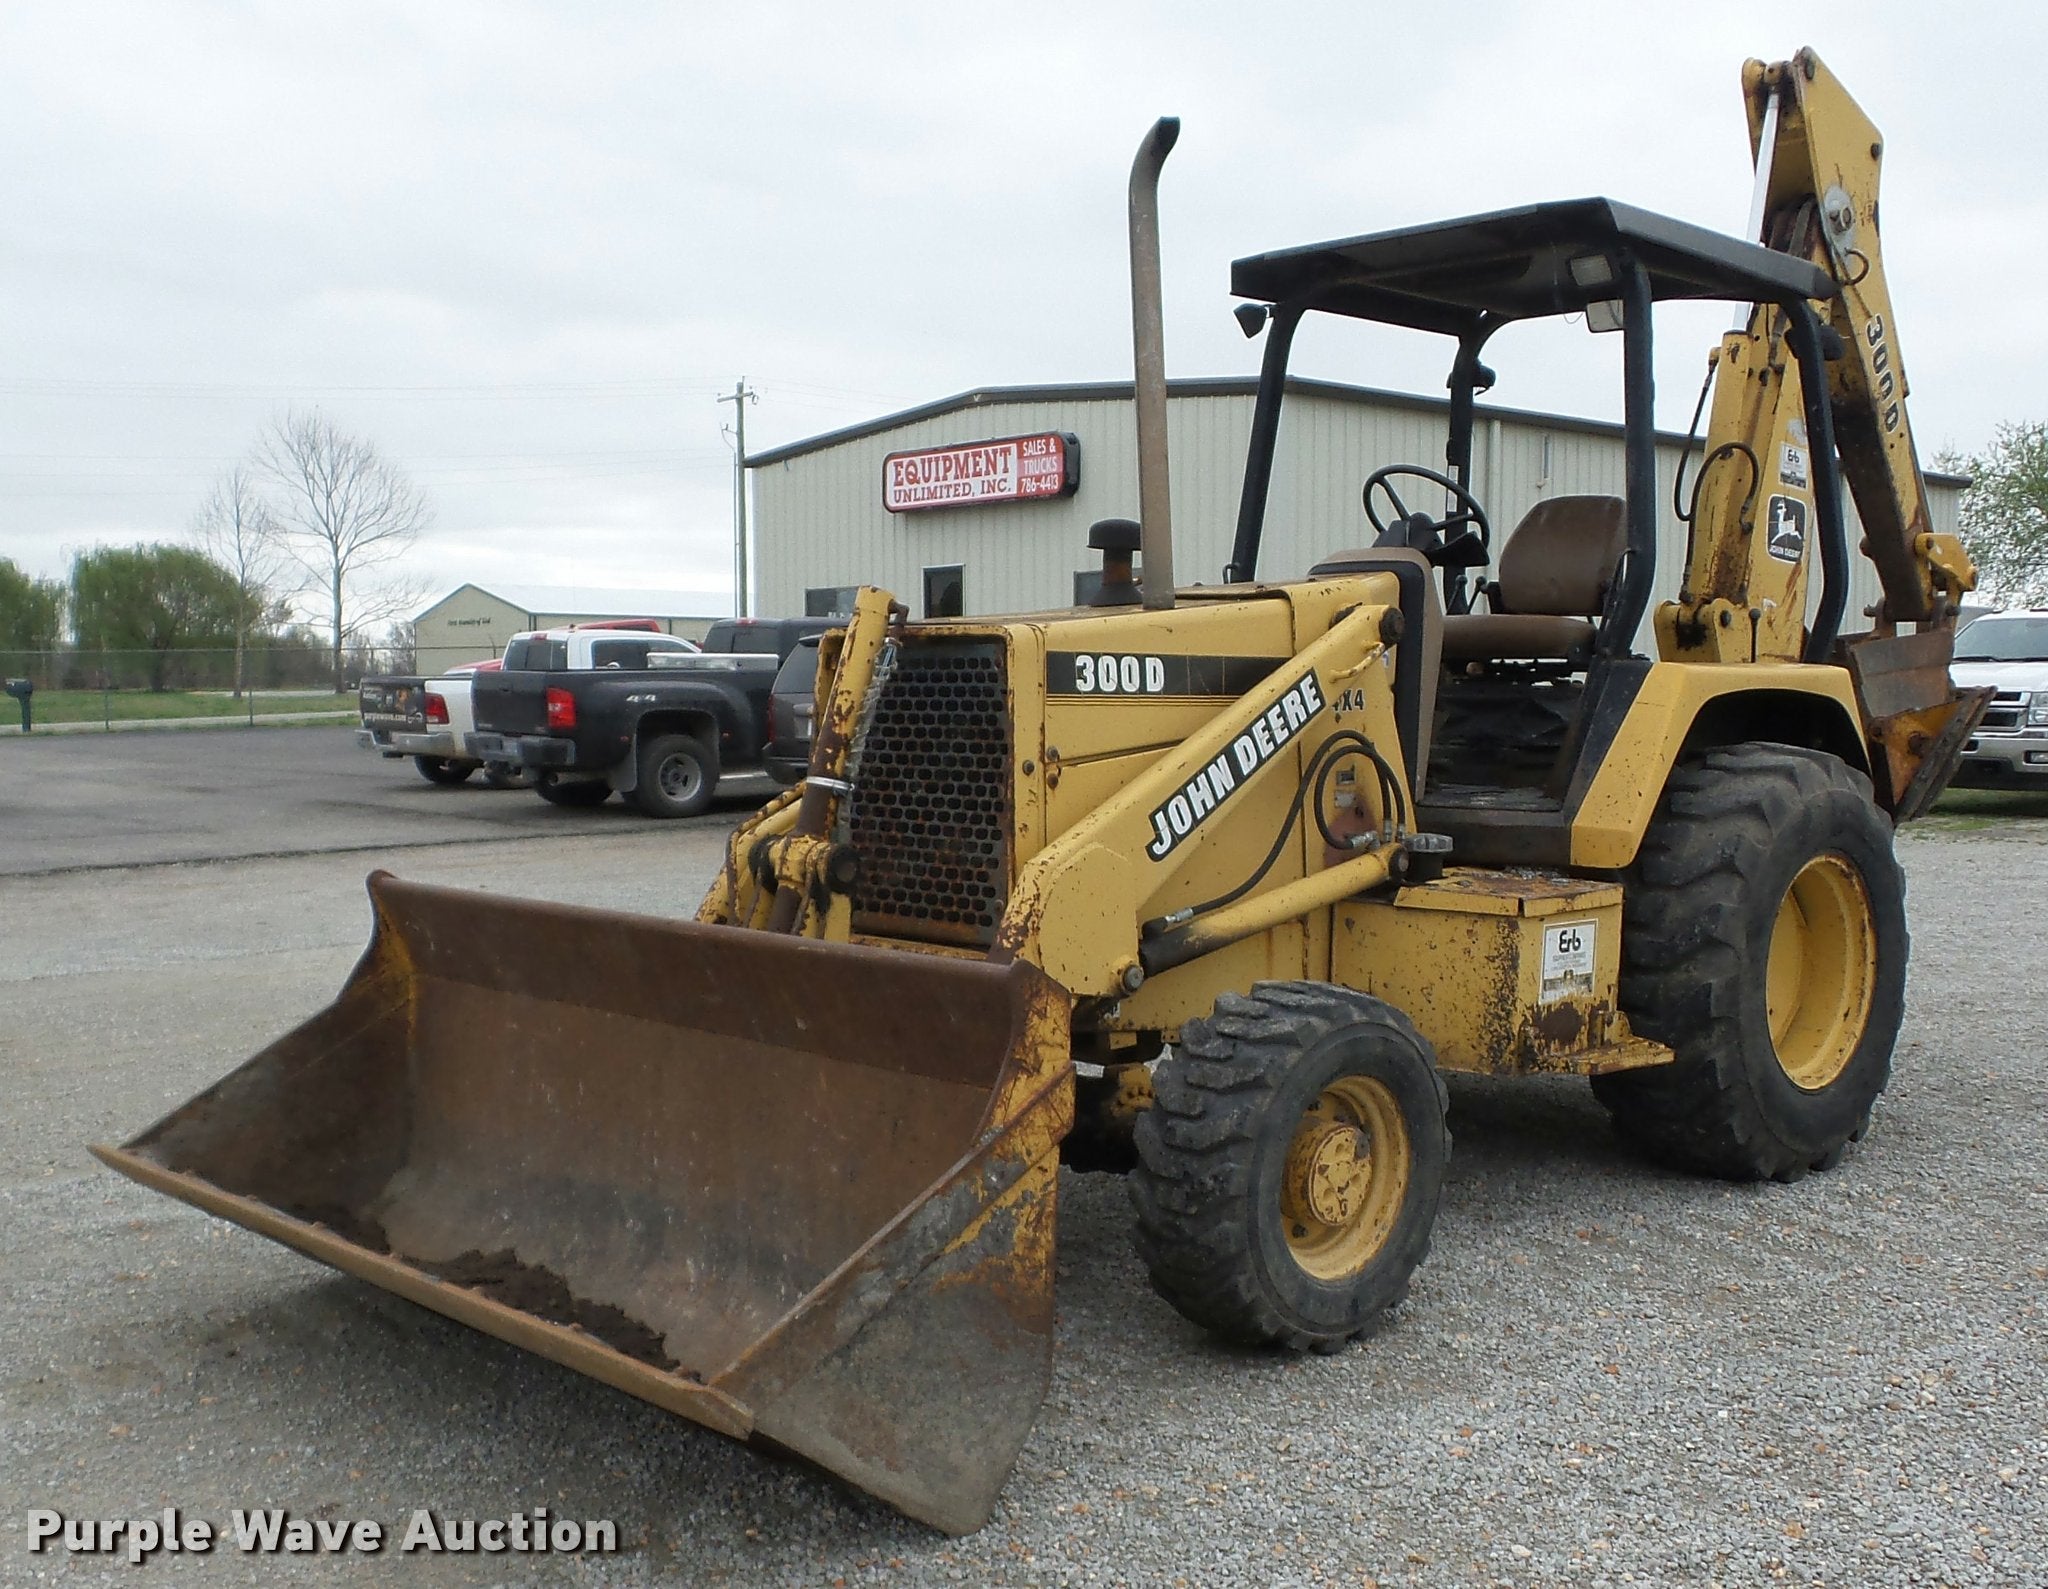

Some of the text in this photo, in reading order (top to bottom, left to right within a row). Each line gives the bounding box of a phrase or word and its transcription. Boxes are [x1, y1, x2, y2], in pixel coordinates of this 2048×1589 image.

[1866, 313, 1900, 433] 300D
[893, 446, 1012, 487] EQUIPMENT
[1023, 437, 1056, 457] SALES &
[1024, 456, 1057, 475] TRUCKS
[894, 478, 1011, 504] UNLIMITED, INC.
[1076, 654, 1165, 693] 300D
[1151, 673, 1322, 856] JOHN DEERE
